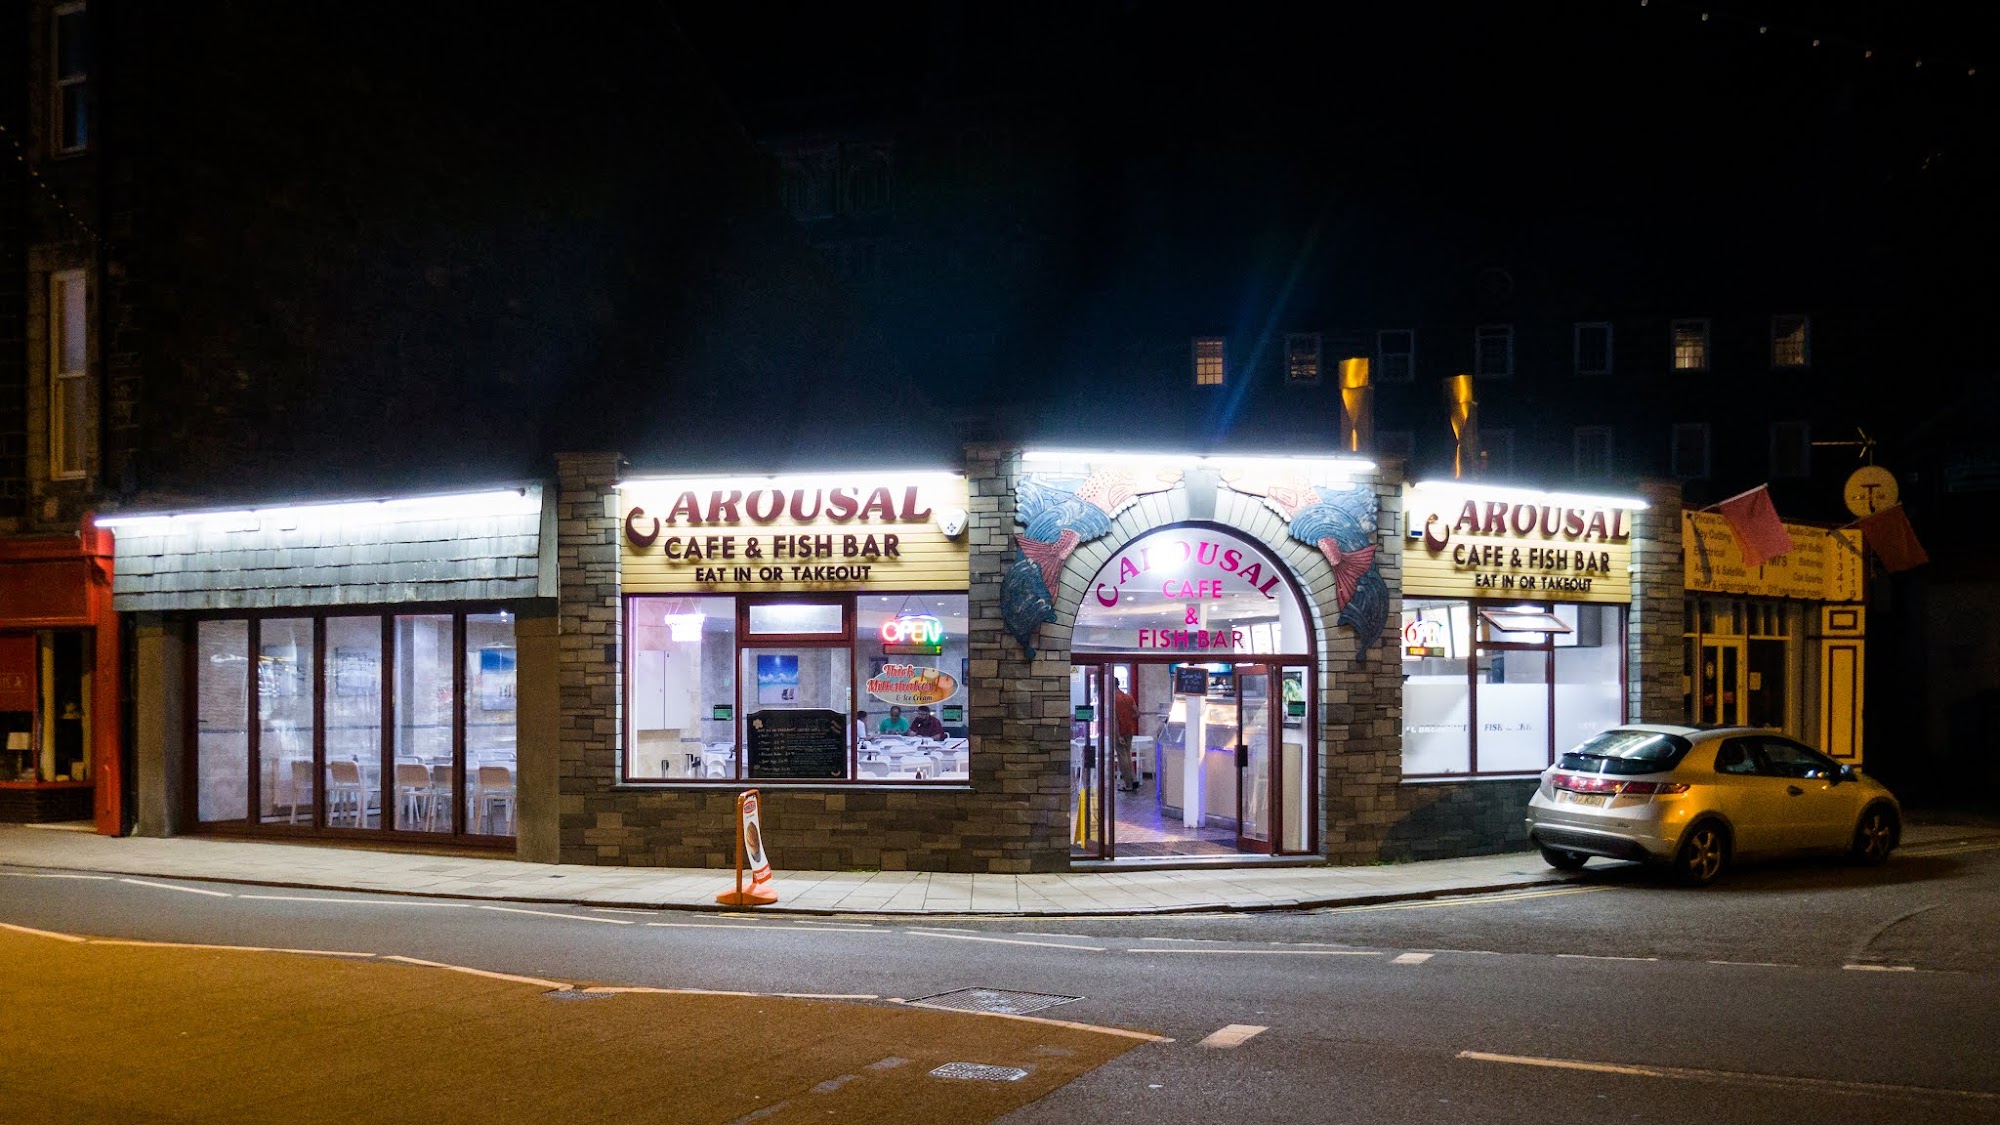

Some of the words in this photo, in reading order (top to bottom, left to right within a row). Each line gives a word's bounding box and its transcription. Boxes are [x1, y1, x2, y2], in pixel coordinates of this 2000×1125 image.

[664, 536, 735, 560] CAFE
[746, 538, 762, 559] &
[773, 534, 833, 558] FISH
[843, 533, 900, 557] BAR
[1453, 544, 1503, 567] CAFE
[1510, 548, 1522, 568] &
[1529, 549, 1568, 570] FISH
[1574, 550, 1610, 572] BAR
[696, 567, 726, 582] EAT
[734, 567, 752, 582] IN
[759, 566, 783, 581] OR
[791, 565, 871, 581] TAKEOUT
[1162, 579, 1222, 598] CAFE
[1475, 574, 1497, 588] EAT
[1502, 575, 1514, 588] IN
[1520, 576, 1535, 589] OR
[1541, 577, 1592, 592] TAKEOUT
[1184, 607, 1199, 625] &
[882, 620, 941, 643] OPEN
[1138, 629, 1189, 648] FISH
[1196, 631, 1244, 649] BAR
[884, 664, 915, 677] Thick
[867, 678, 934, 693] Milkshakes
